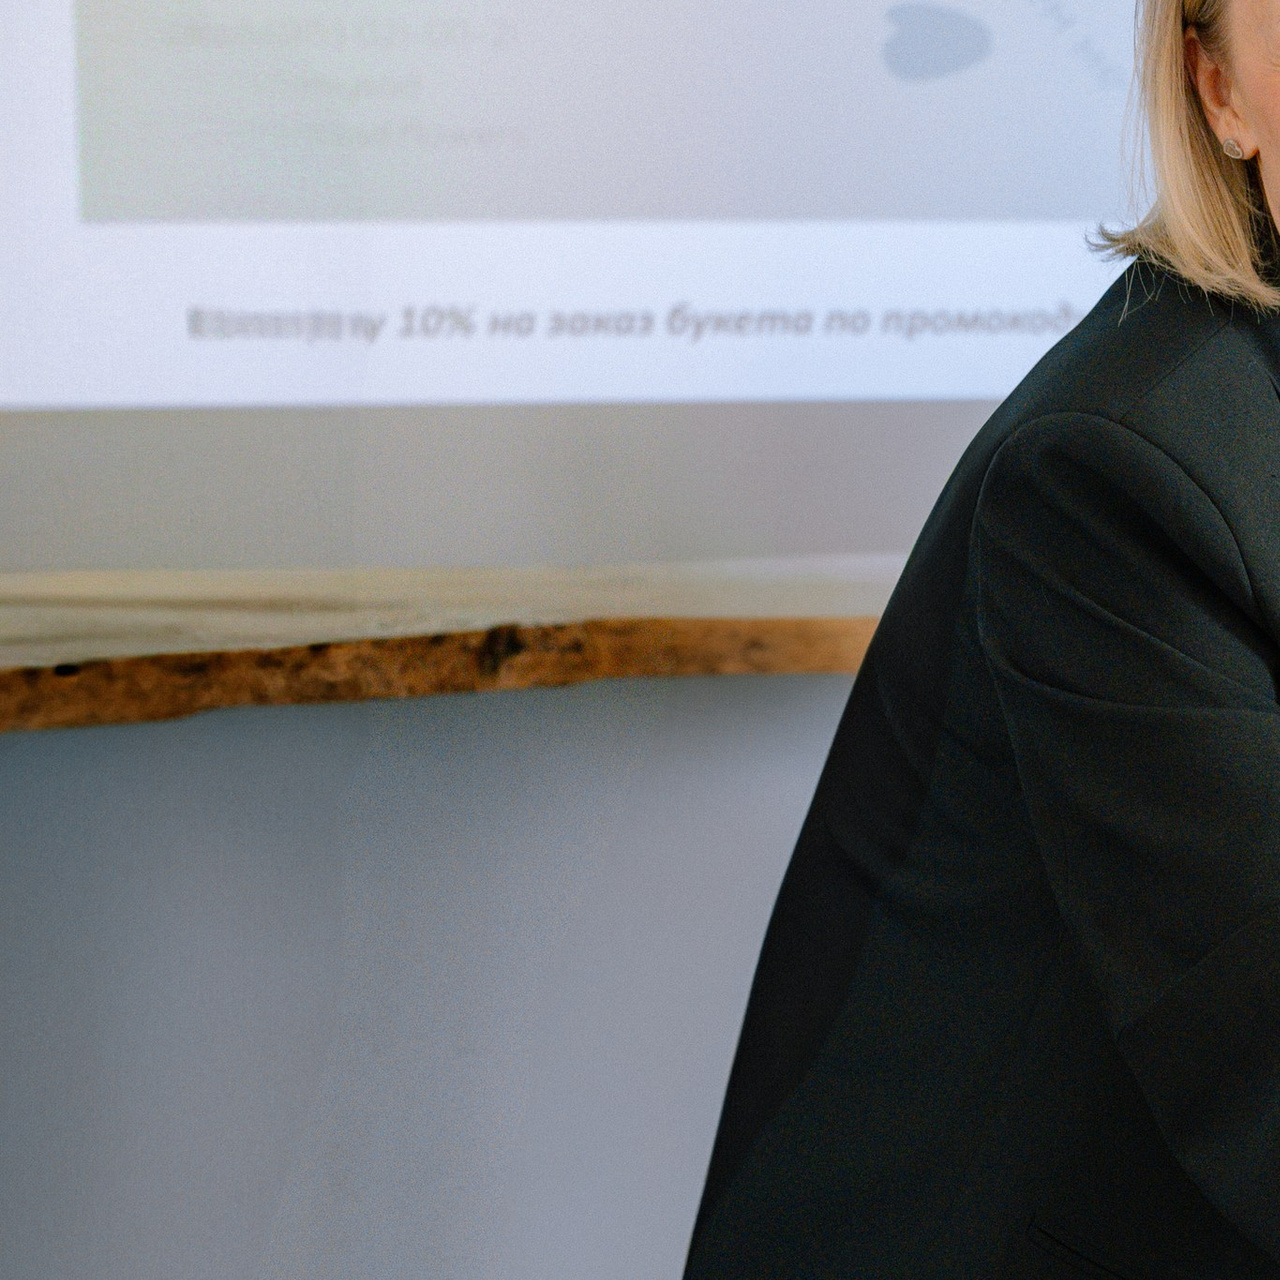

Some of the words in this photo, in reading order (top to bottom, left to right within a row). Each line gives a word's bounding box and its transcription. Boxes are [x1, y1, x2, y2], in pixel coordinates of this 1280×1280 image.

[401, 303, 477, 339] 10%
[488, 311, 537, 339] на
[548, 309, 653, 340] заказ
[666, 301, 813, 346] букета
[823, 309, 872, 335] по
